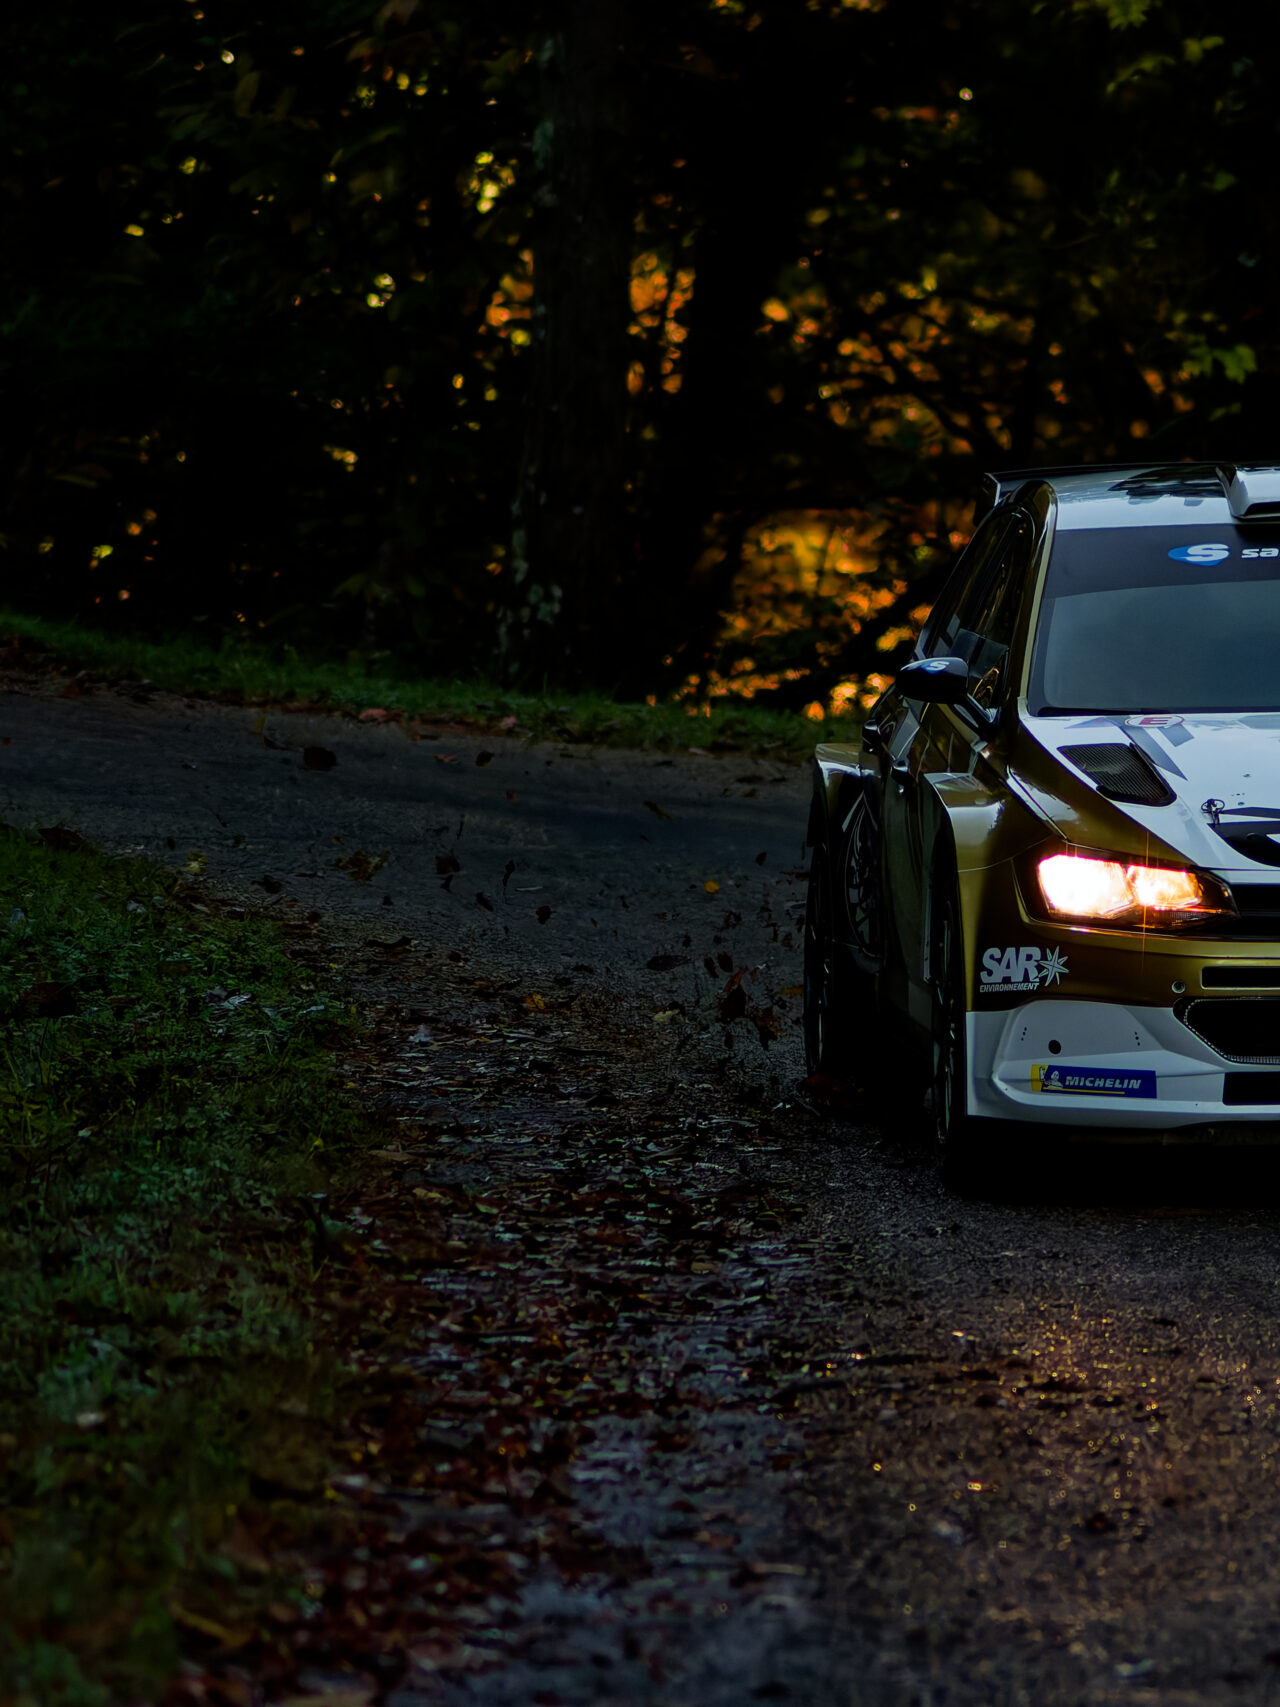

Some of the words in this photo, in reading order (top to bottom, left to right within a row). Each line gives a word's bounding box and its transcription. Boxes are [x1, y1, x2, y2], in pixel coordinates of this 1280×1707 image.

[980, 946, 1041, 983] SAR
[979, 982, 1040, 993] ENVIRONNEMENT
[1065, 1076, 1142, 1089] MICHELIN
